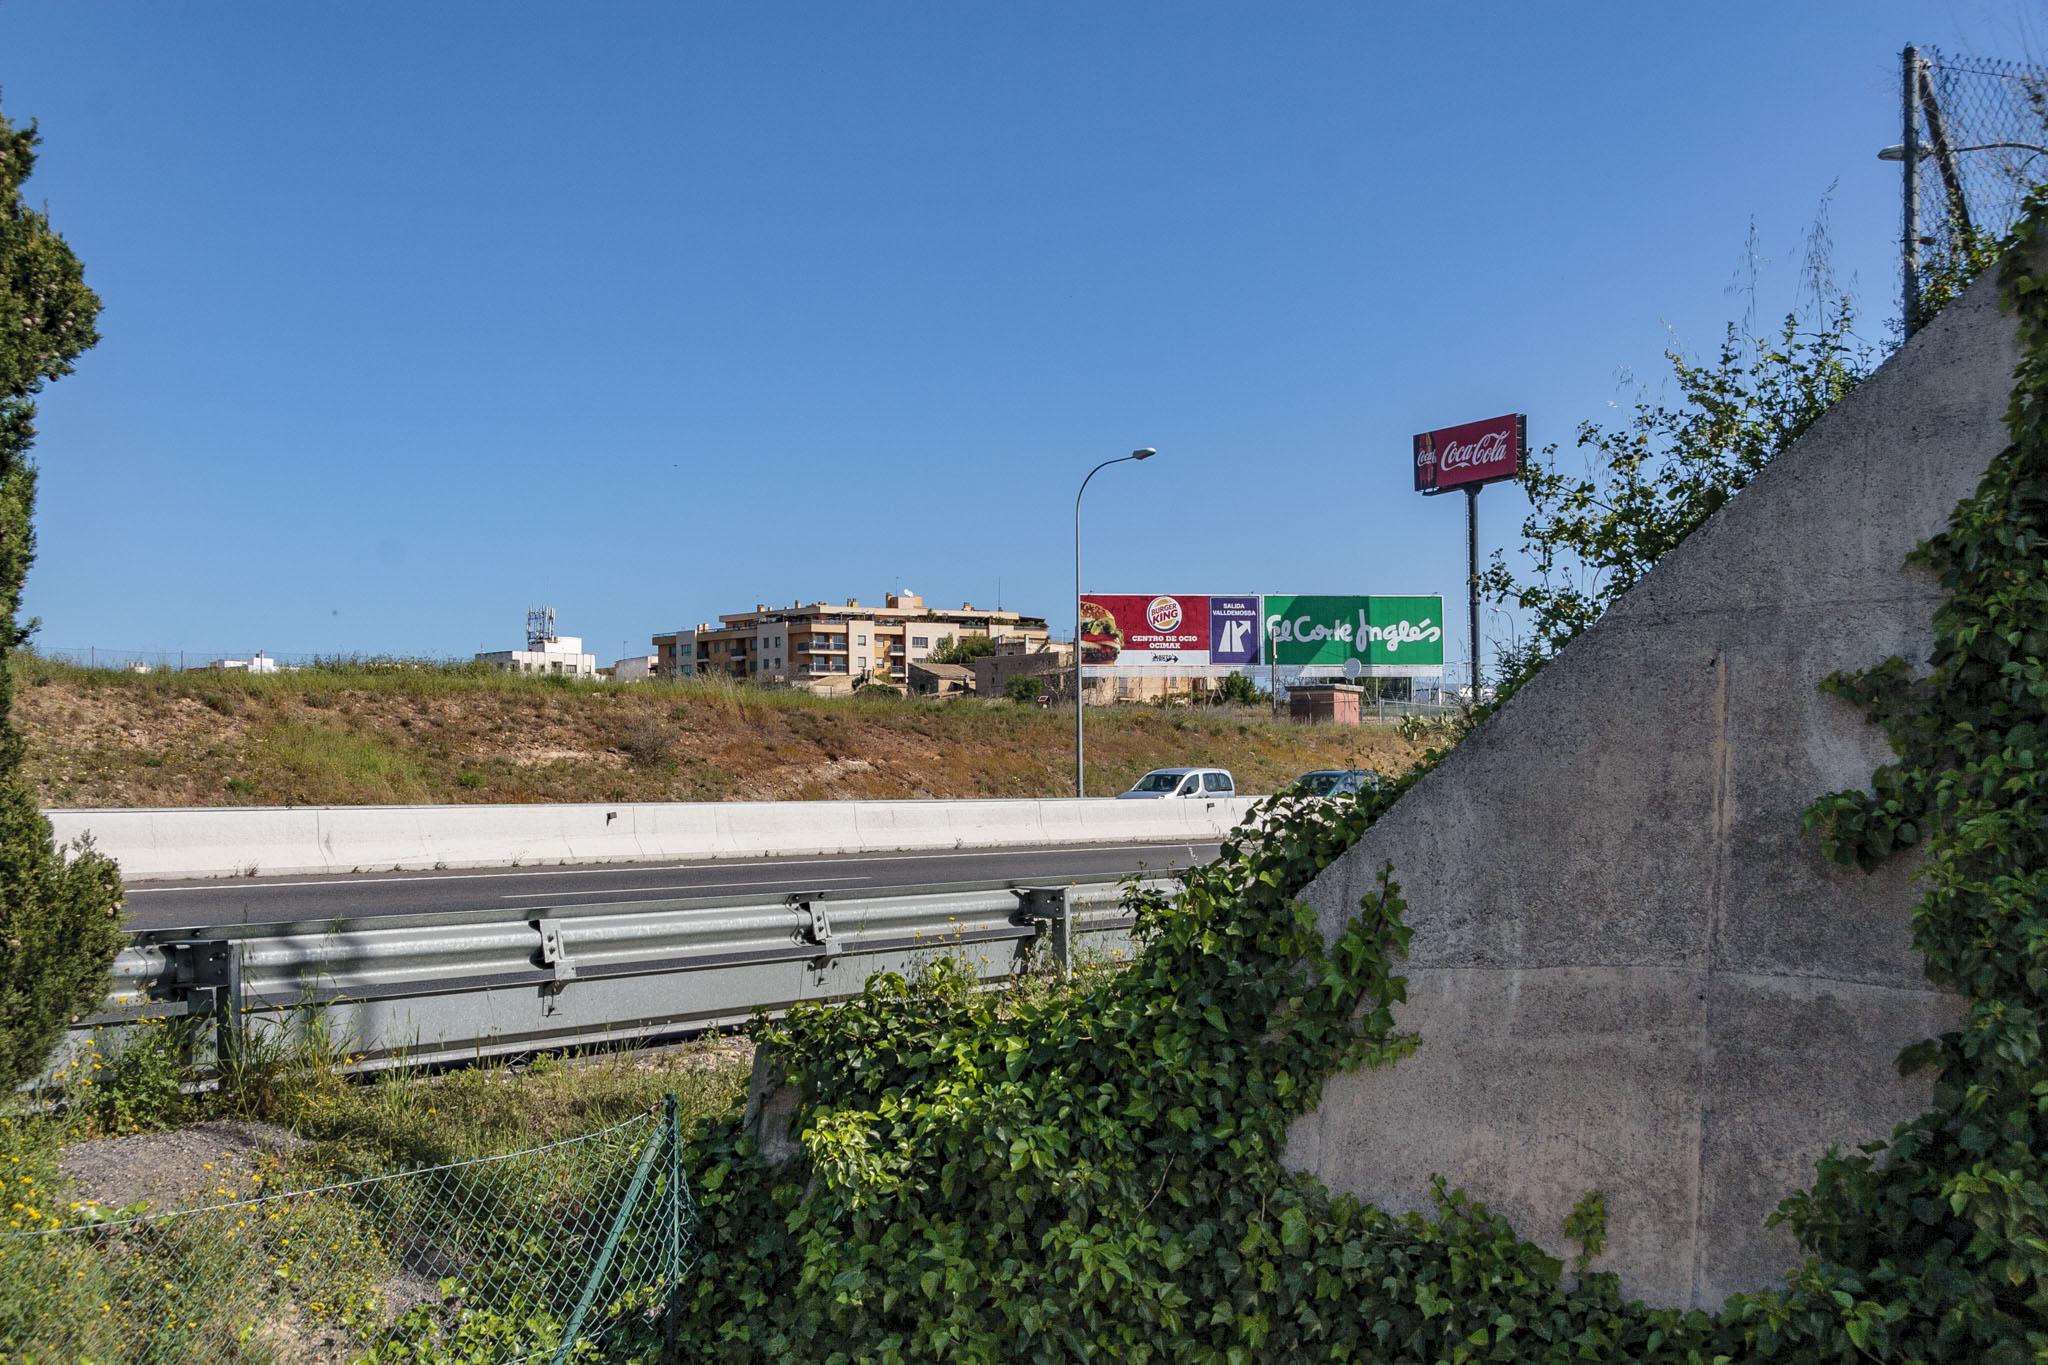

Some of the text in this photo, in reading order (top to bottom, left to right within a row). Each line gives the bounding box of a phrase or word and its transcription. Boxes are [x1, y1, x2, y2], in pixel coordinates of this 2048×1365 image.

[1441, 430, 1510, 471] Coca-Cola
[1151, 603, 1177, 615] BURGER
[1152, 609, 1178, 625] KING
[1266, 608, 1441, 652] El Corte Inglés
